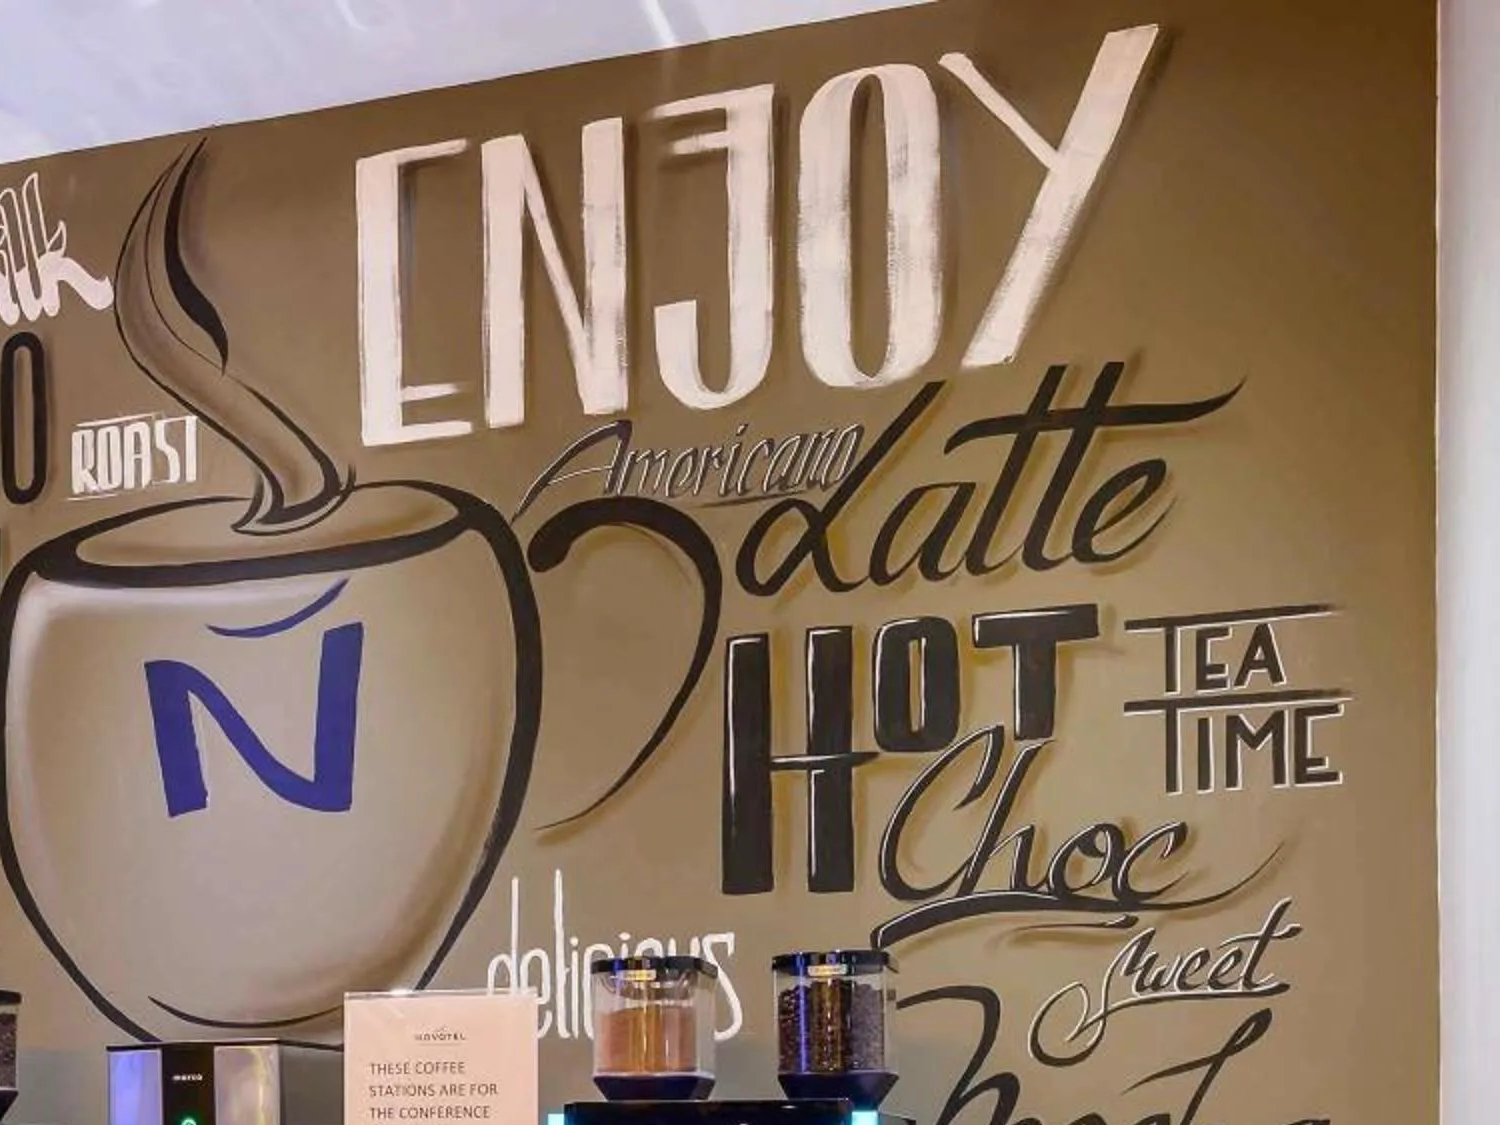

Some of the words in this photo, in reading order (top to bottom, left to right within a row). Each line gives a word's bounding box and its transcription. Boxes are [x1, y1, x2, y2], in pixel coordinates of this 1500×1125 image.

[355, 23, 1159, 447] ENJOY
[70, 414, 199, 496] ROAST
[510, 419, 864, 525] Americano
[735, 361, 1248, 597] Latte
[1124, 605, 1345, 696] TEA
[721, 604, 1100, 895] HOT
[1123, 690, 1355, 796] TIME
[876, 724, 1190, 904] Choc
[487, 868, 743, 1042] delics
[1010, 897, 1303, 1067] Sweet
[369, 1084, 436, 1098] STATIONS
[439, 1084, 467, 1097] ARE
[470, 1083, 499, 1096] FOR
[370, 1062, 410, 1075] THESE
[415, 1061, 466, 1075] COFFEE
[370, 1106, 396, 1120] THE
[399, 1105, 491, 1119] CONFERENCE
